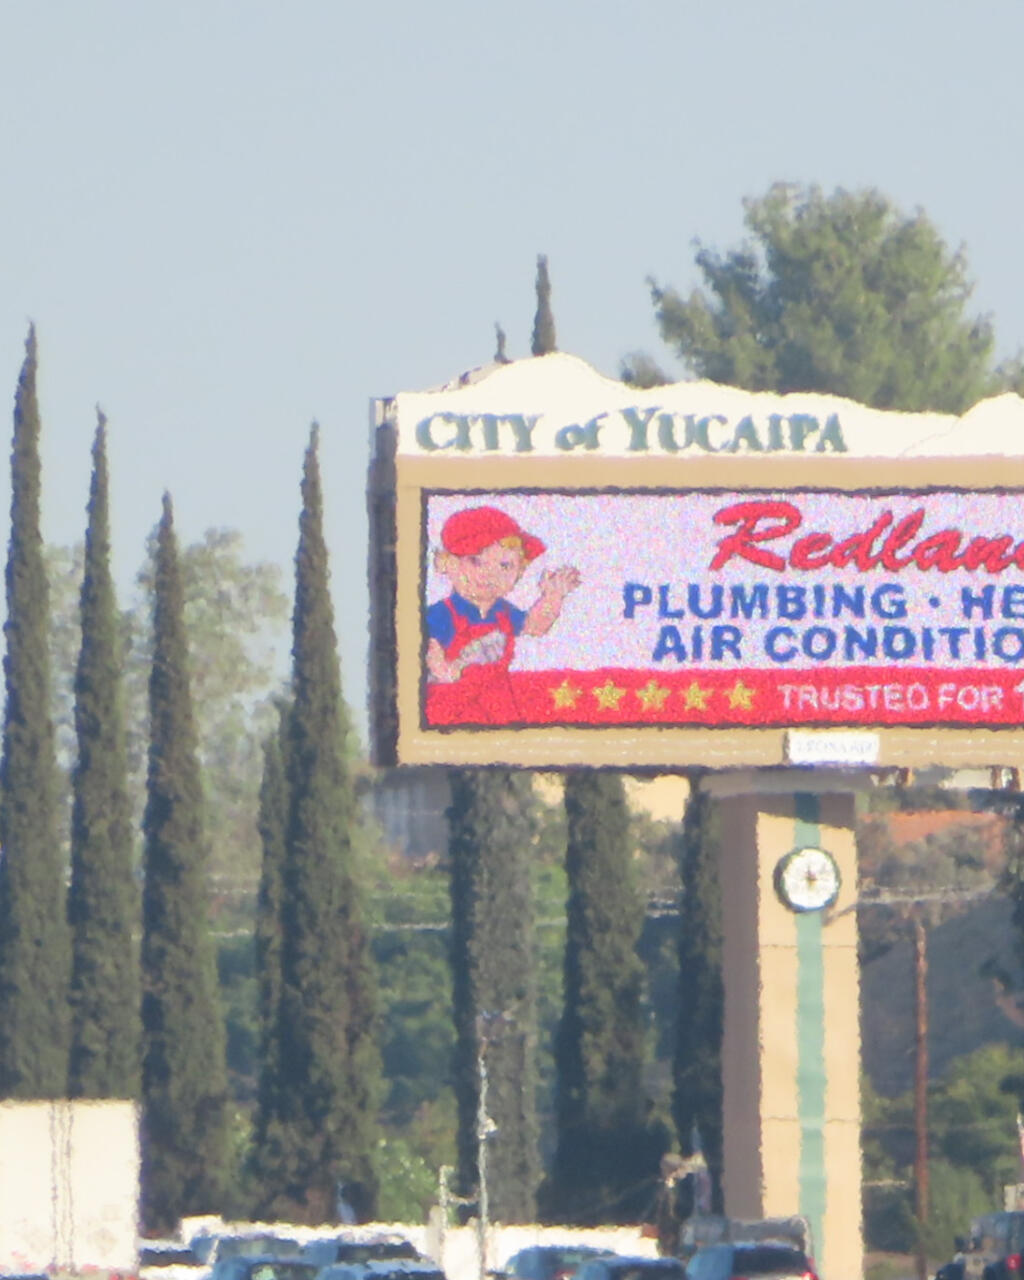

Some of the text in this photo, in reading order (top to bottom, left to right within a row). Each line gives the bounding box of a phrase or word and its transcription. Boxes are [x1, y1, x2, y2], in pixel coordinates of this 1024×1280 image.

[415, 405, 849, 453] CITY of YUCAIPA
[623, 582, 908, 620] PLUMBING
[652, 626, 743, 662] AIR
[778, 684, 929, 712] TRUSTED
[937, 683, 1003, 712] FOR
